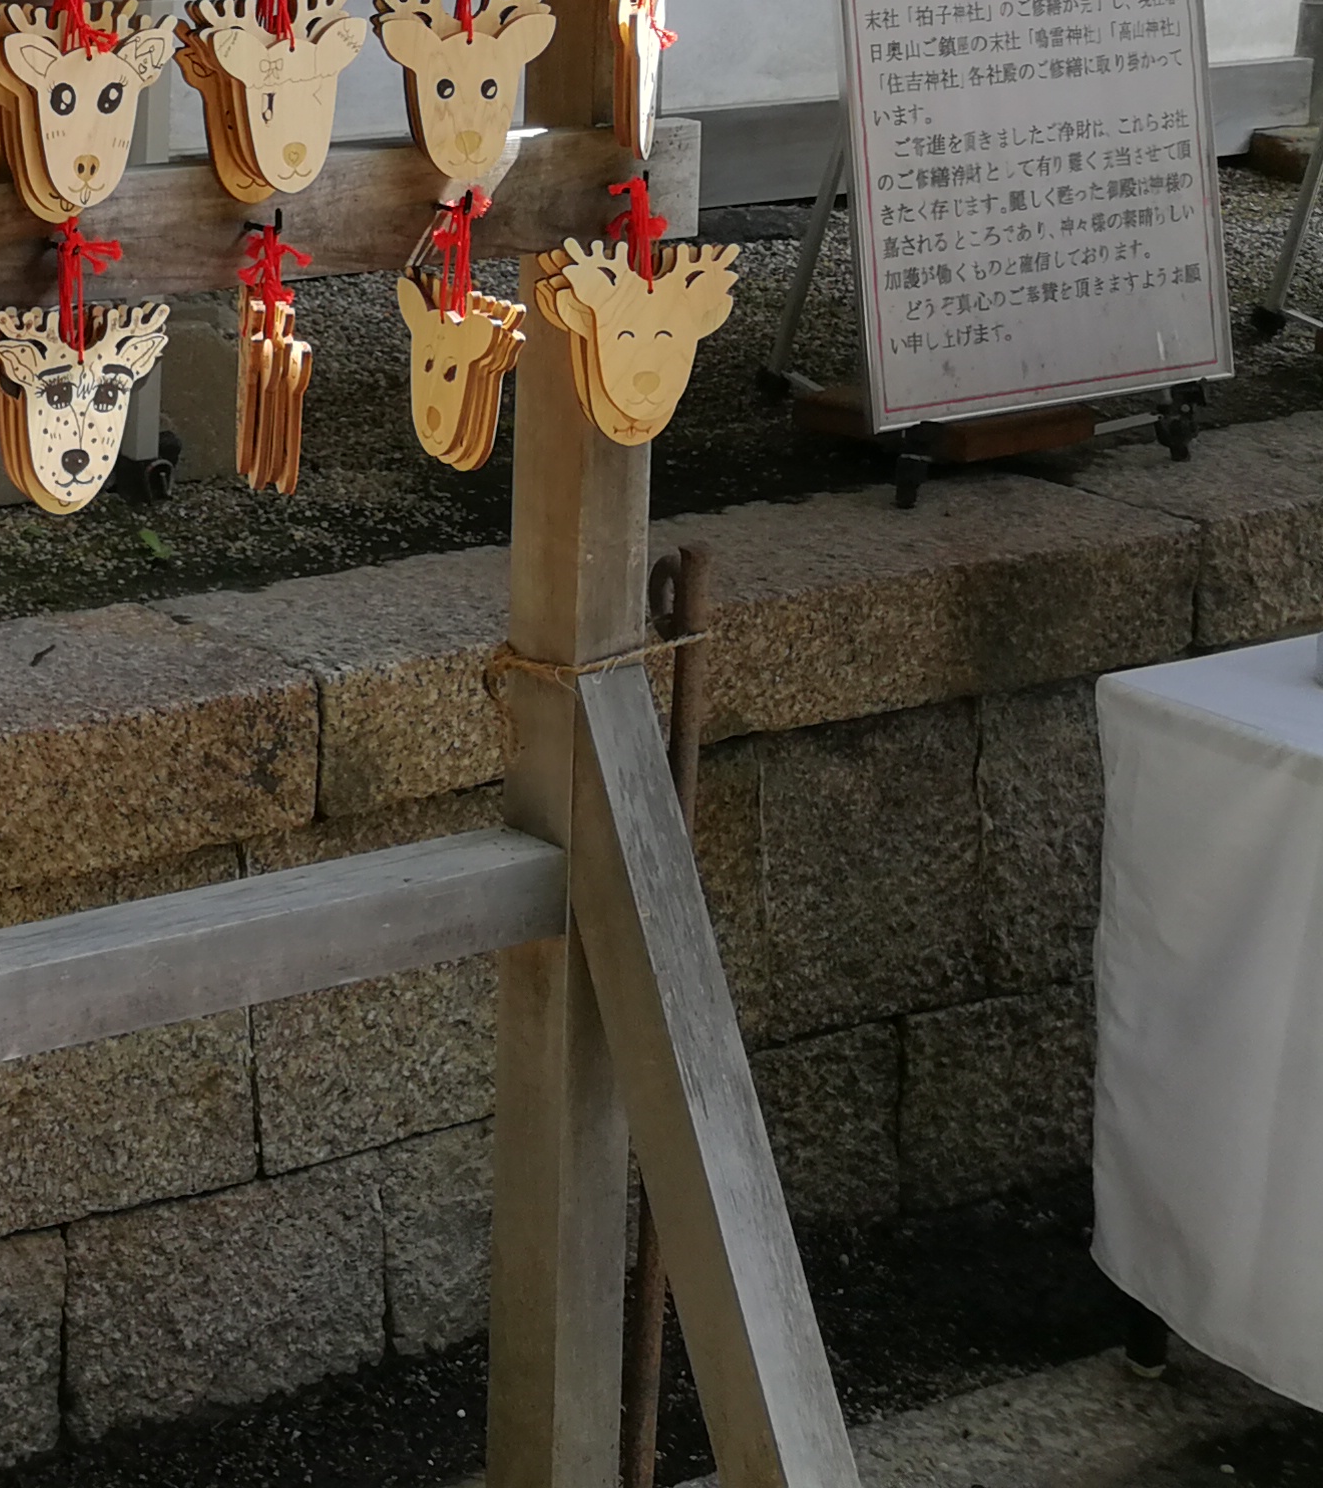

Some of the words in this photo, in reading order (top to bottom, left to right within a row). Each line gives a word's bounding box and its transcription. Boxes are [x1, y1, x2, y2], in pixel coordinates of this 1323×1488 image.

[873, 104, 932, 127] います。
[890, 323, 1012, 355] い申し上げます。
